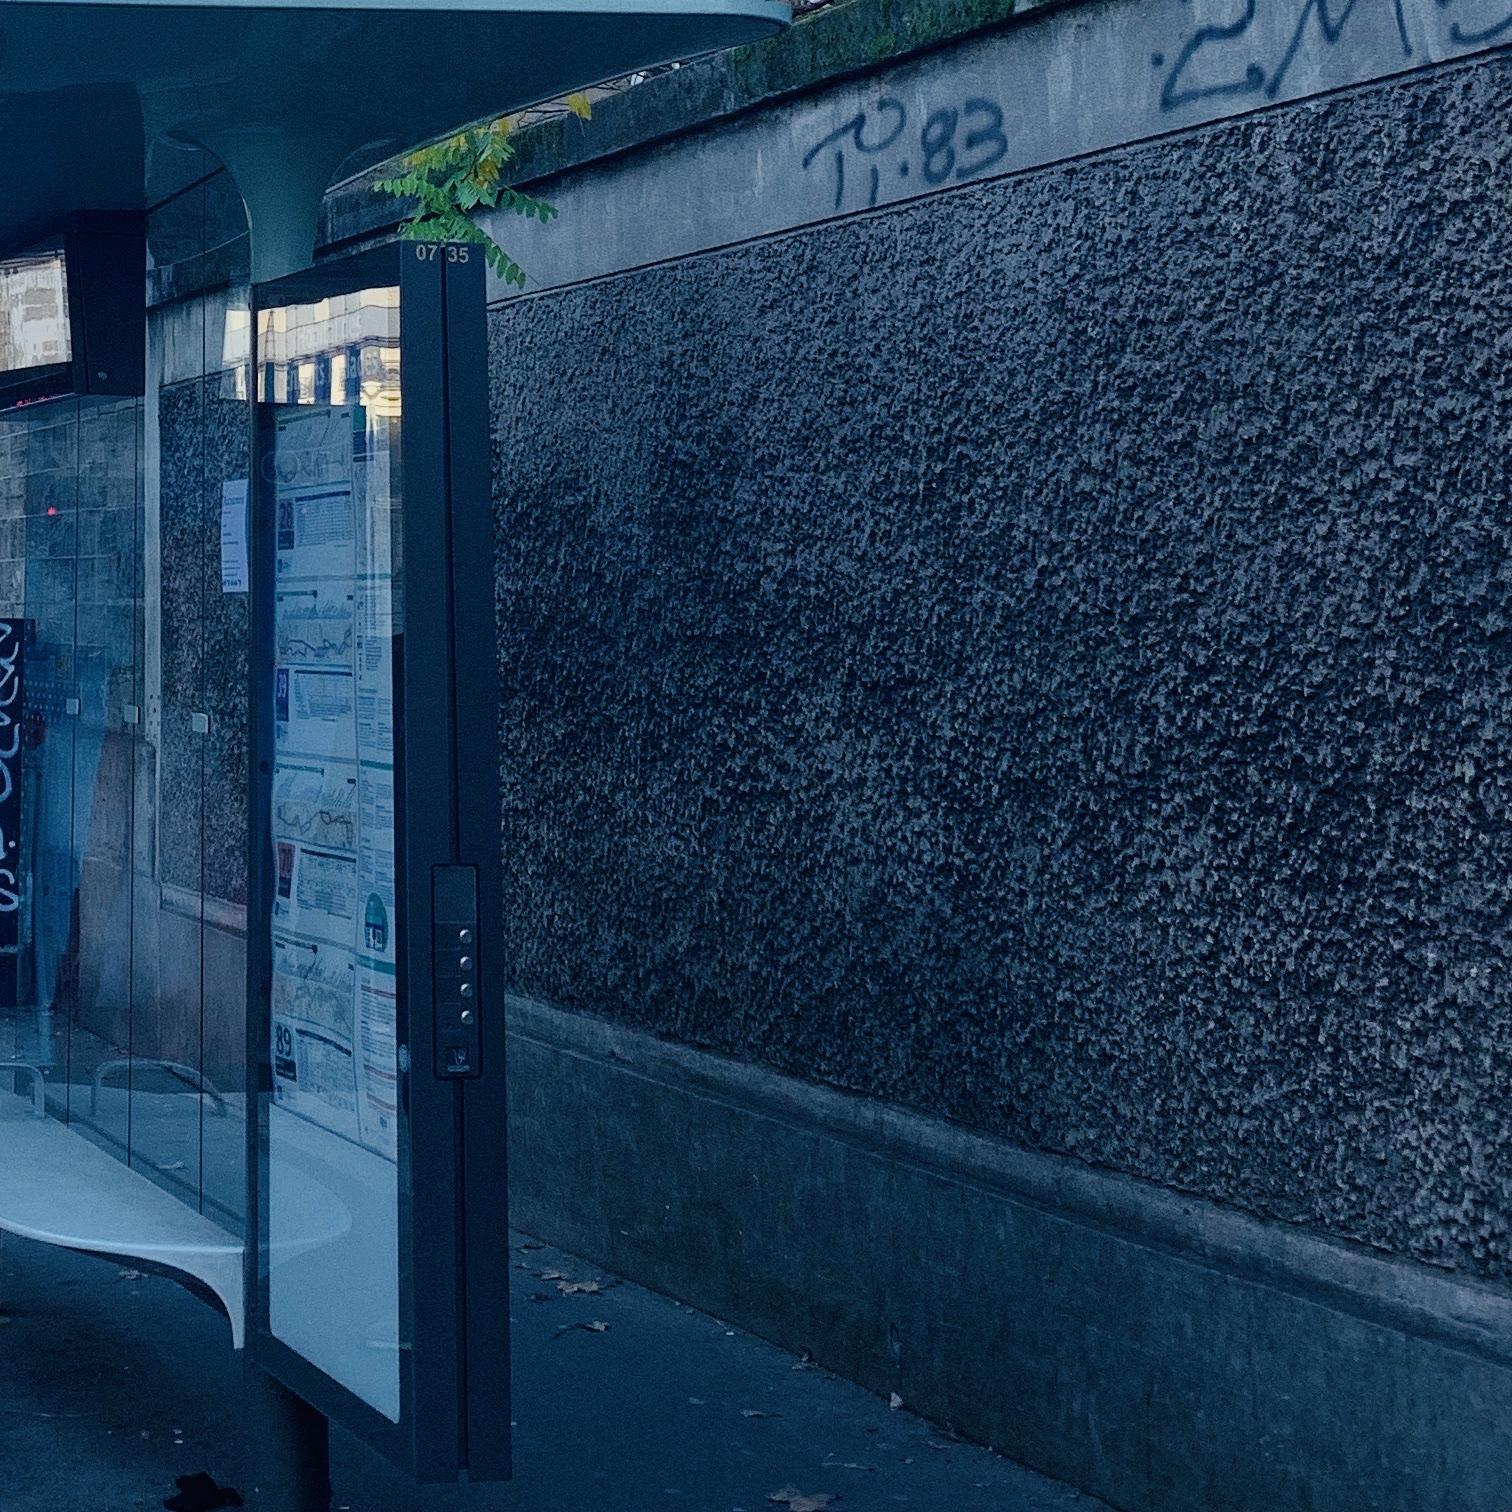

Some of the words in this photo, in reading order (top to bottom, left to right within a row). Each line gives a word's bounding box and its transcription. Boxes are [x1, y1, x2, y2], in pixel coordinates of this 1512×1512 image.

[415, 244, 438, 261] 07
[447, 246, 469, 264] 35
[276, 1024, 292, 1058] 89
